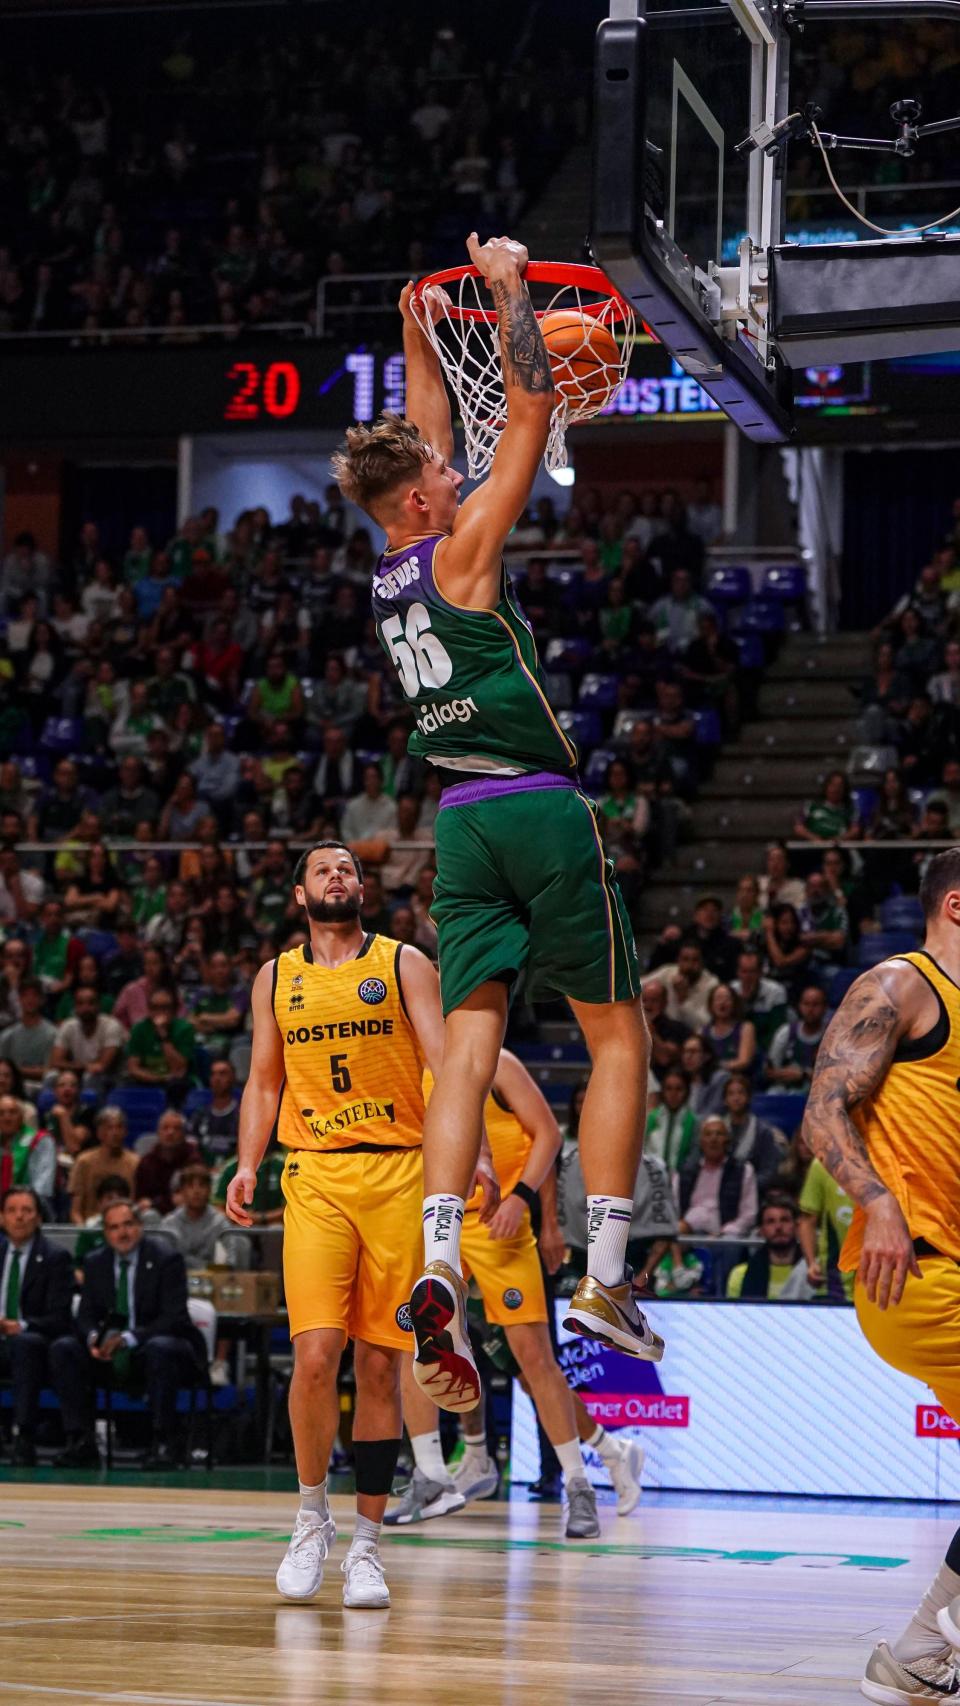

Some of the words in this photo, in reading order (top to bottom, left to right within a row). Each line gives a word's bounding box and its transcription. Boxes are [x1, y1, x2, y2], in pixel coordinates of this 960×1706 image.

[224, 361, 300, 420] 20
[381, 602, 453, 698] 56
[286, 1019, 394, 1046] OOSTENDE
[329, 1053, 352, 1094] 5
[310, 1102, 385, 1139] KASTEEL
[433, 1204, 455, 1243] UNICAJA
[624, 1398, 684, 1420] Outlet
